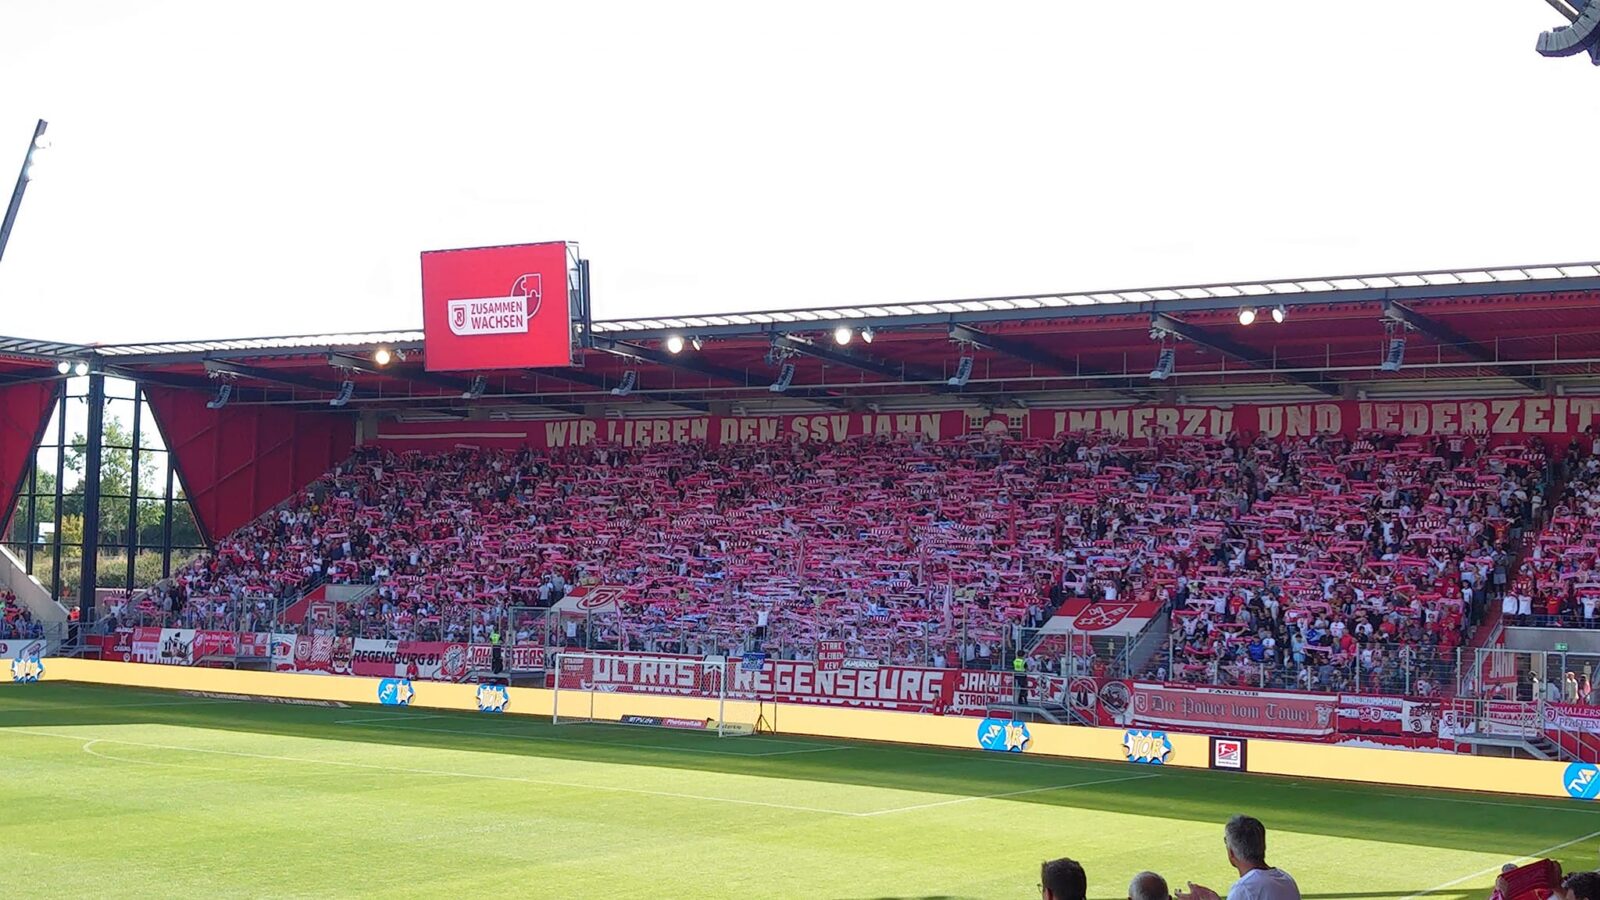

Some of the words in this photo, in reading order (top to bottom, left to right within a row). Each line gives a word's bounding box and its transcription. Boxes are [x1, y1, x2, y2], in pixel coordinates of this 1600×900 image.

[470, 301, 523, 315] ZUSAMMEN
[470, 315, 524, 330] WACHSEN
[545, 419, 598, 447] WIR
[607, 418, 710, 447] LIEBEN
[719, 418, 778, 445] DEN
[791, 415, 850, 443] SSV
[1053, 407, 1235, 440] IMMERZU
[1257, 404, 1342, 437] UND
[821, 642, 842, 650] STARK
[593, 654, 695, 686] ULTRAS
[734, 661, 944, 701] REGENSBURG
[958, 671, 1000, 694] JAHN
[1151, 695, 1176, 712] Die
[1182, 696, 1226, 716] Power
[1231, 704, 1261, 718] vom
[1265, 703, 1312, 722] Tower
[981, 724, 1002, 745] TVA
[1130, 736, 1163, 758] TOR
[1568, 766, 1599, 794] TVA
